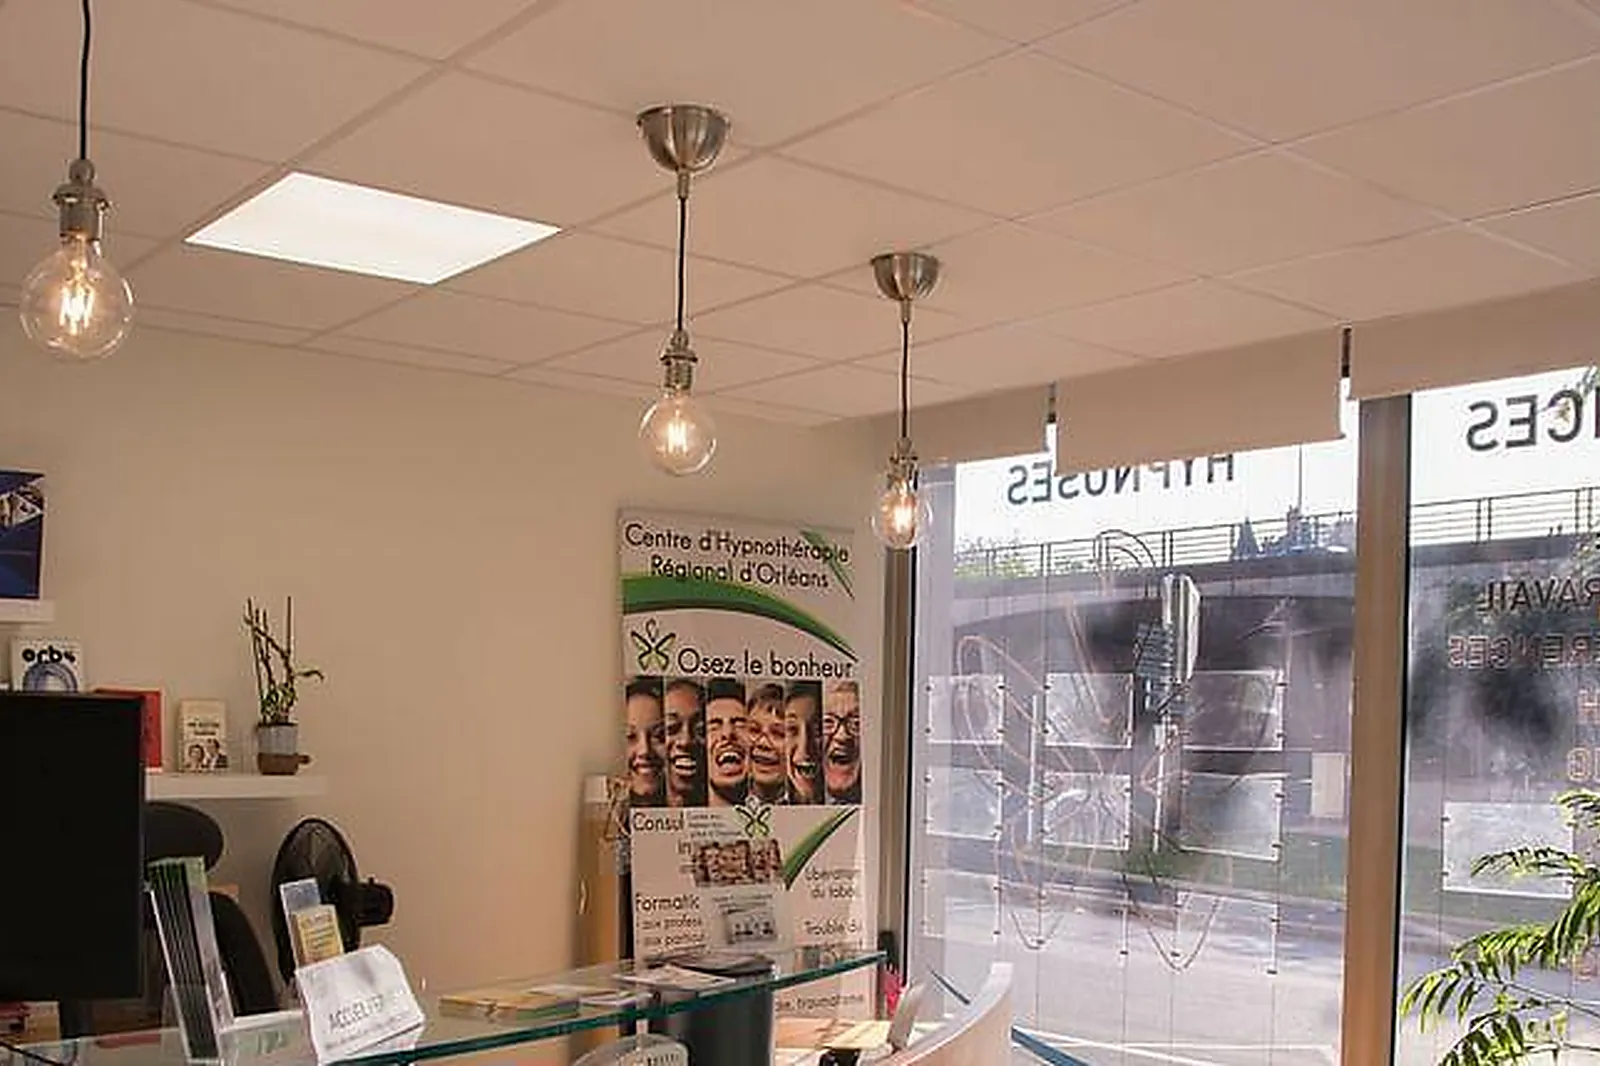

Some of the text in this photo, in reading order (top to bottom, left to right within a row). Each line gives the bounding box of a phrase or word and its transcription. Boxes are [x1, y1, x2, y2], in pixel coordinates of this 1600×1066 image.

[624, 523, 849, 564] Centre d'Hypnothérapie
[651, 554, 829, 589] Régional d'Orléans
[678, 647, 850, 677] Osez le bonheur
